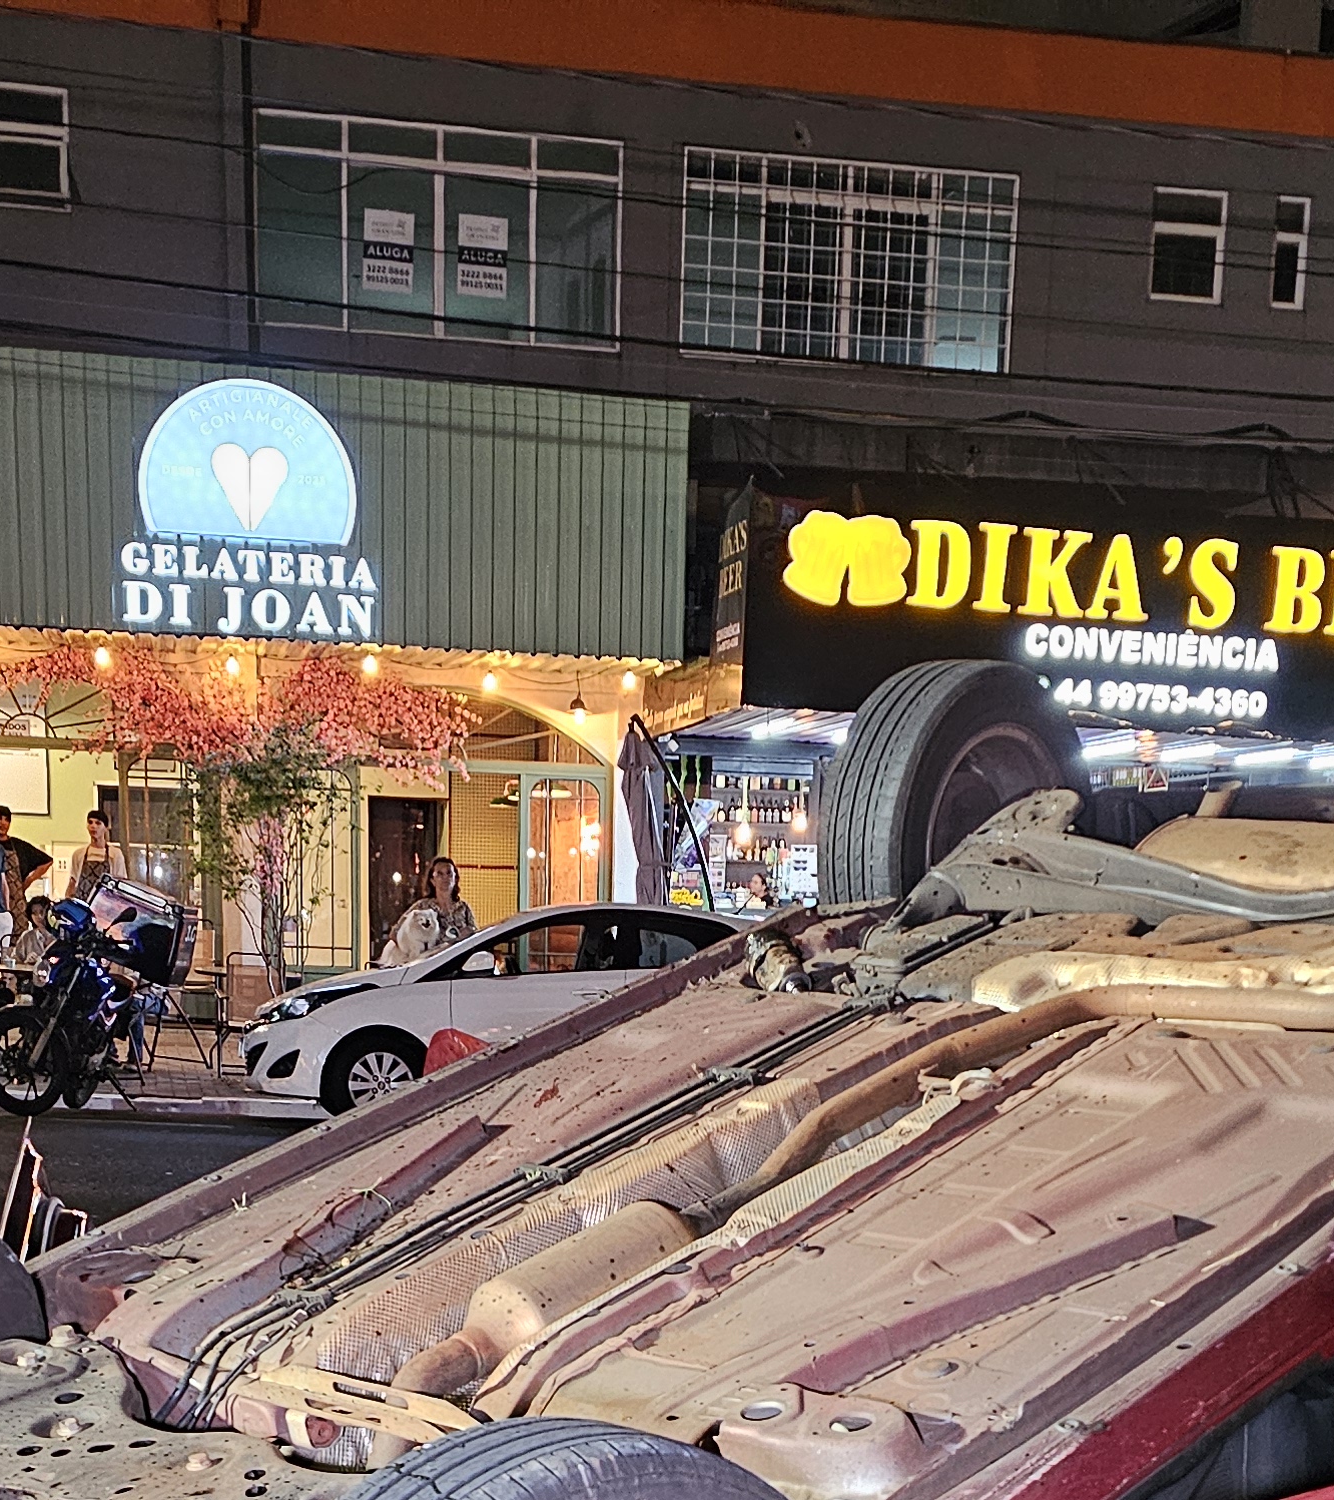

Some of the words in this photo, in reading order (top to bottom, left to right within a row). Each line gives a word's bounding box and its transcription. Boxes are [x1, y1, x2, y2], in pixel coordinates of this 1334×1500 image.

[367, 245, 410, 259] ALUGA
[461, 249, 504, 264] ALUGA
[186, 388, 315, 431] ARTIGIANALE
[199, 408, 237, 437] CON
[241, 408, 306, 448] AMORE
[120, 541, 380, 593] GELATERIA
[906, 518, 1240, 630] DIKA'S
[121, 580, 192, 627] DI
[216, 586, 376, 640] JOAN
[1024, 623, 1280, 674] CONVENIÊNCIA
[1053, 677, 1093, 707] 44
[1097, 680, 1269, 719] 99753-4360
